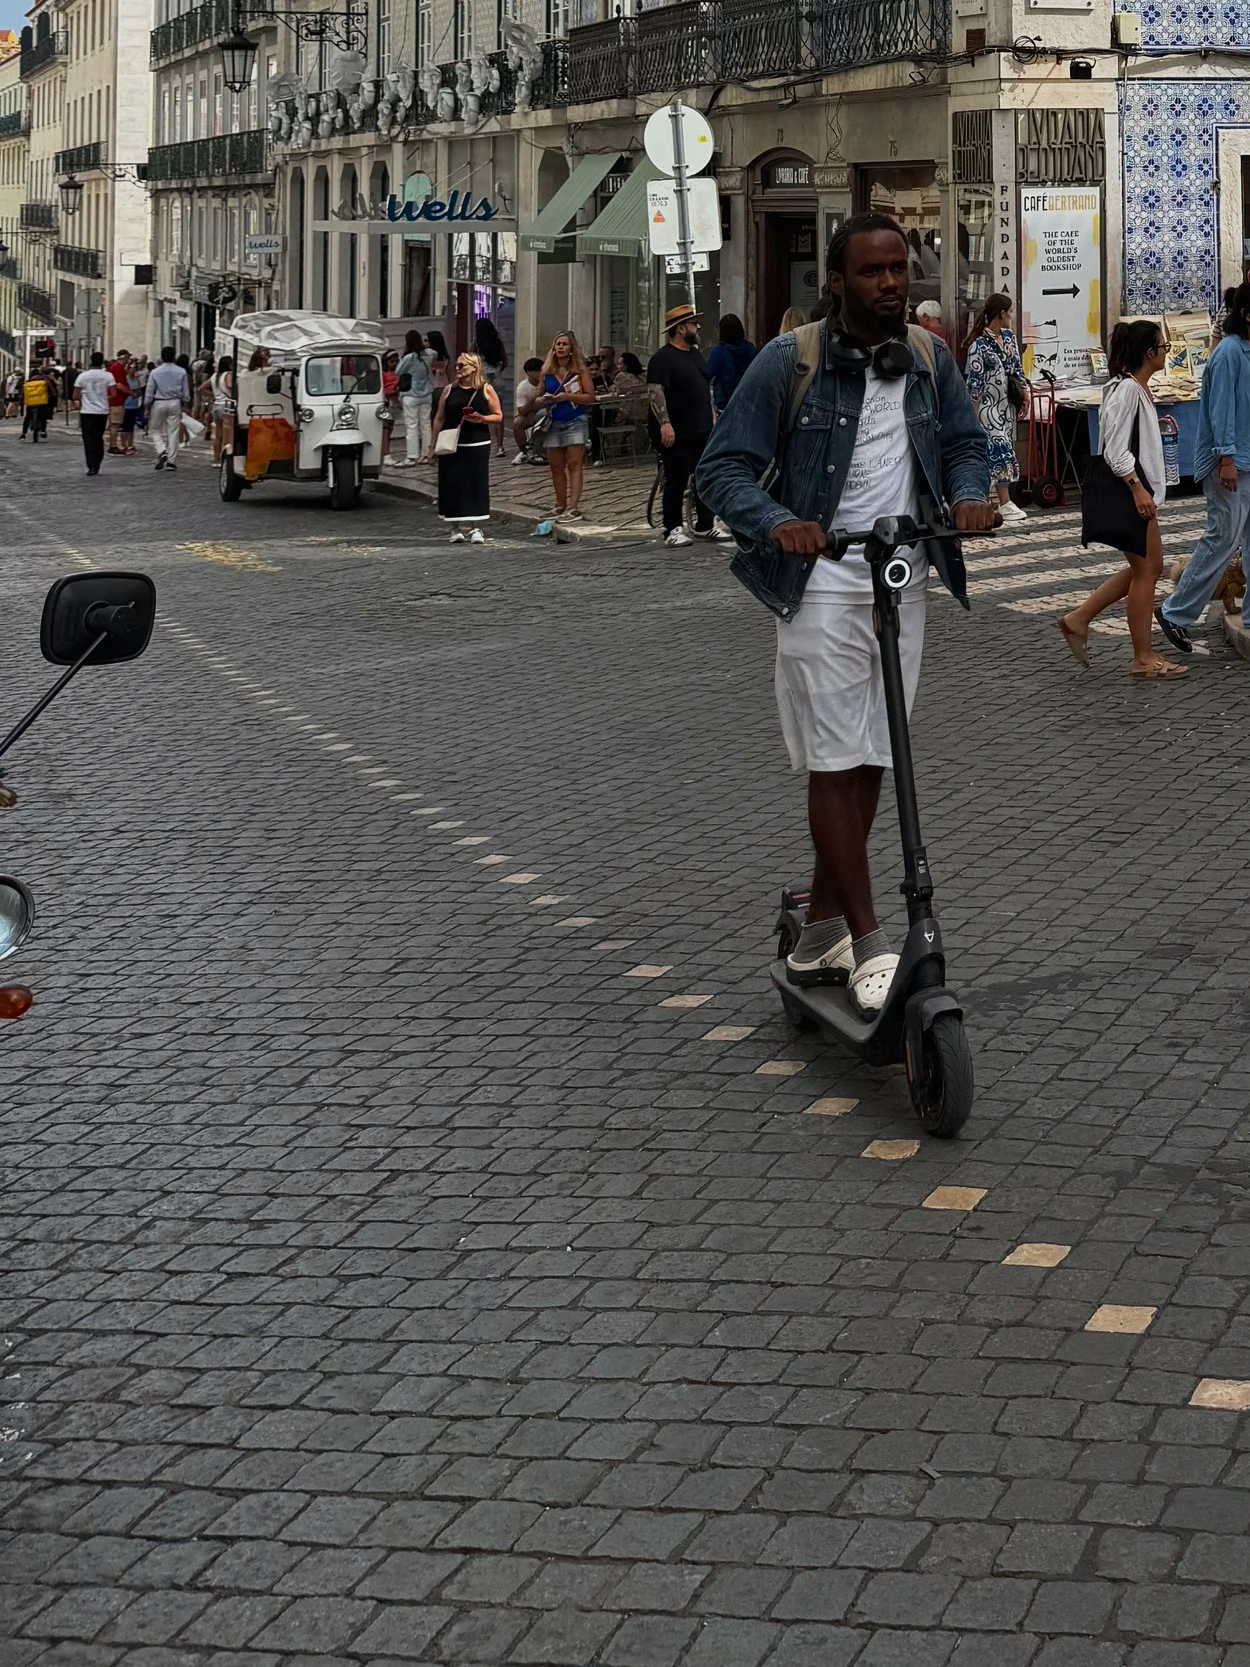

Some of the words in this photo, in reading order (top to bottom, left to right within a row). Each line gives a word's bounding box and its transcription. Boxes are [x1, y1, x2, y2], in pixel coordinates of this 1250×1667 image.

[1016, 144, 1106, 182] BERTRAND
[386, 190, 500, 222] wells
[249, 239, 281, 250] wells
[1044, 247, 1079, 255] WORLD'S
[1046, 255, 1076, 263] OLDEST
[1041, 263, 1082, 272] BOOKSHOP
